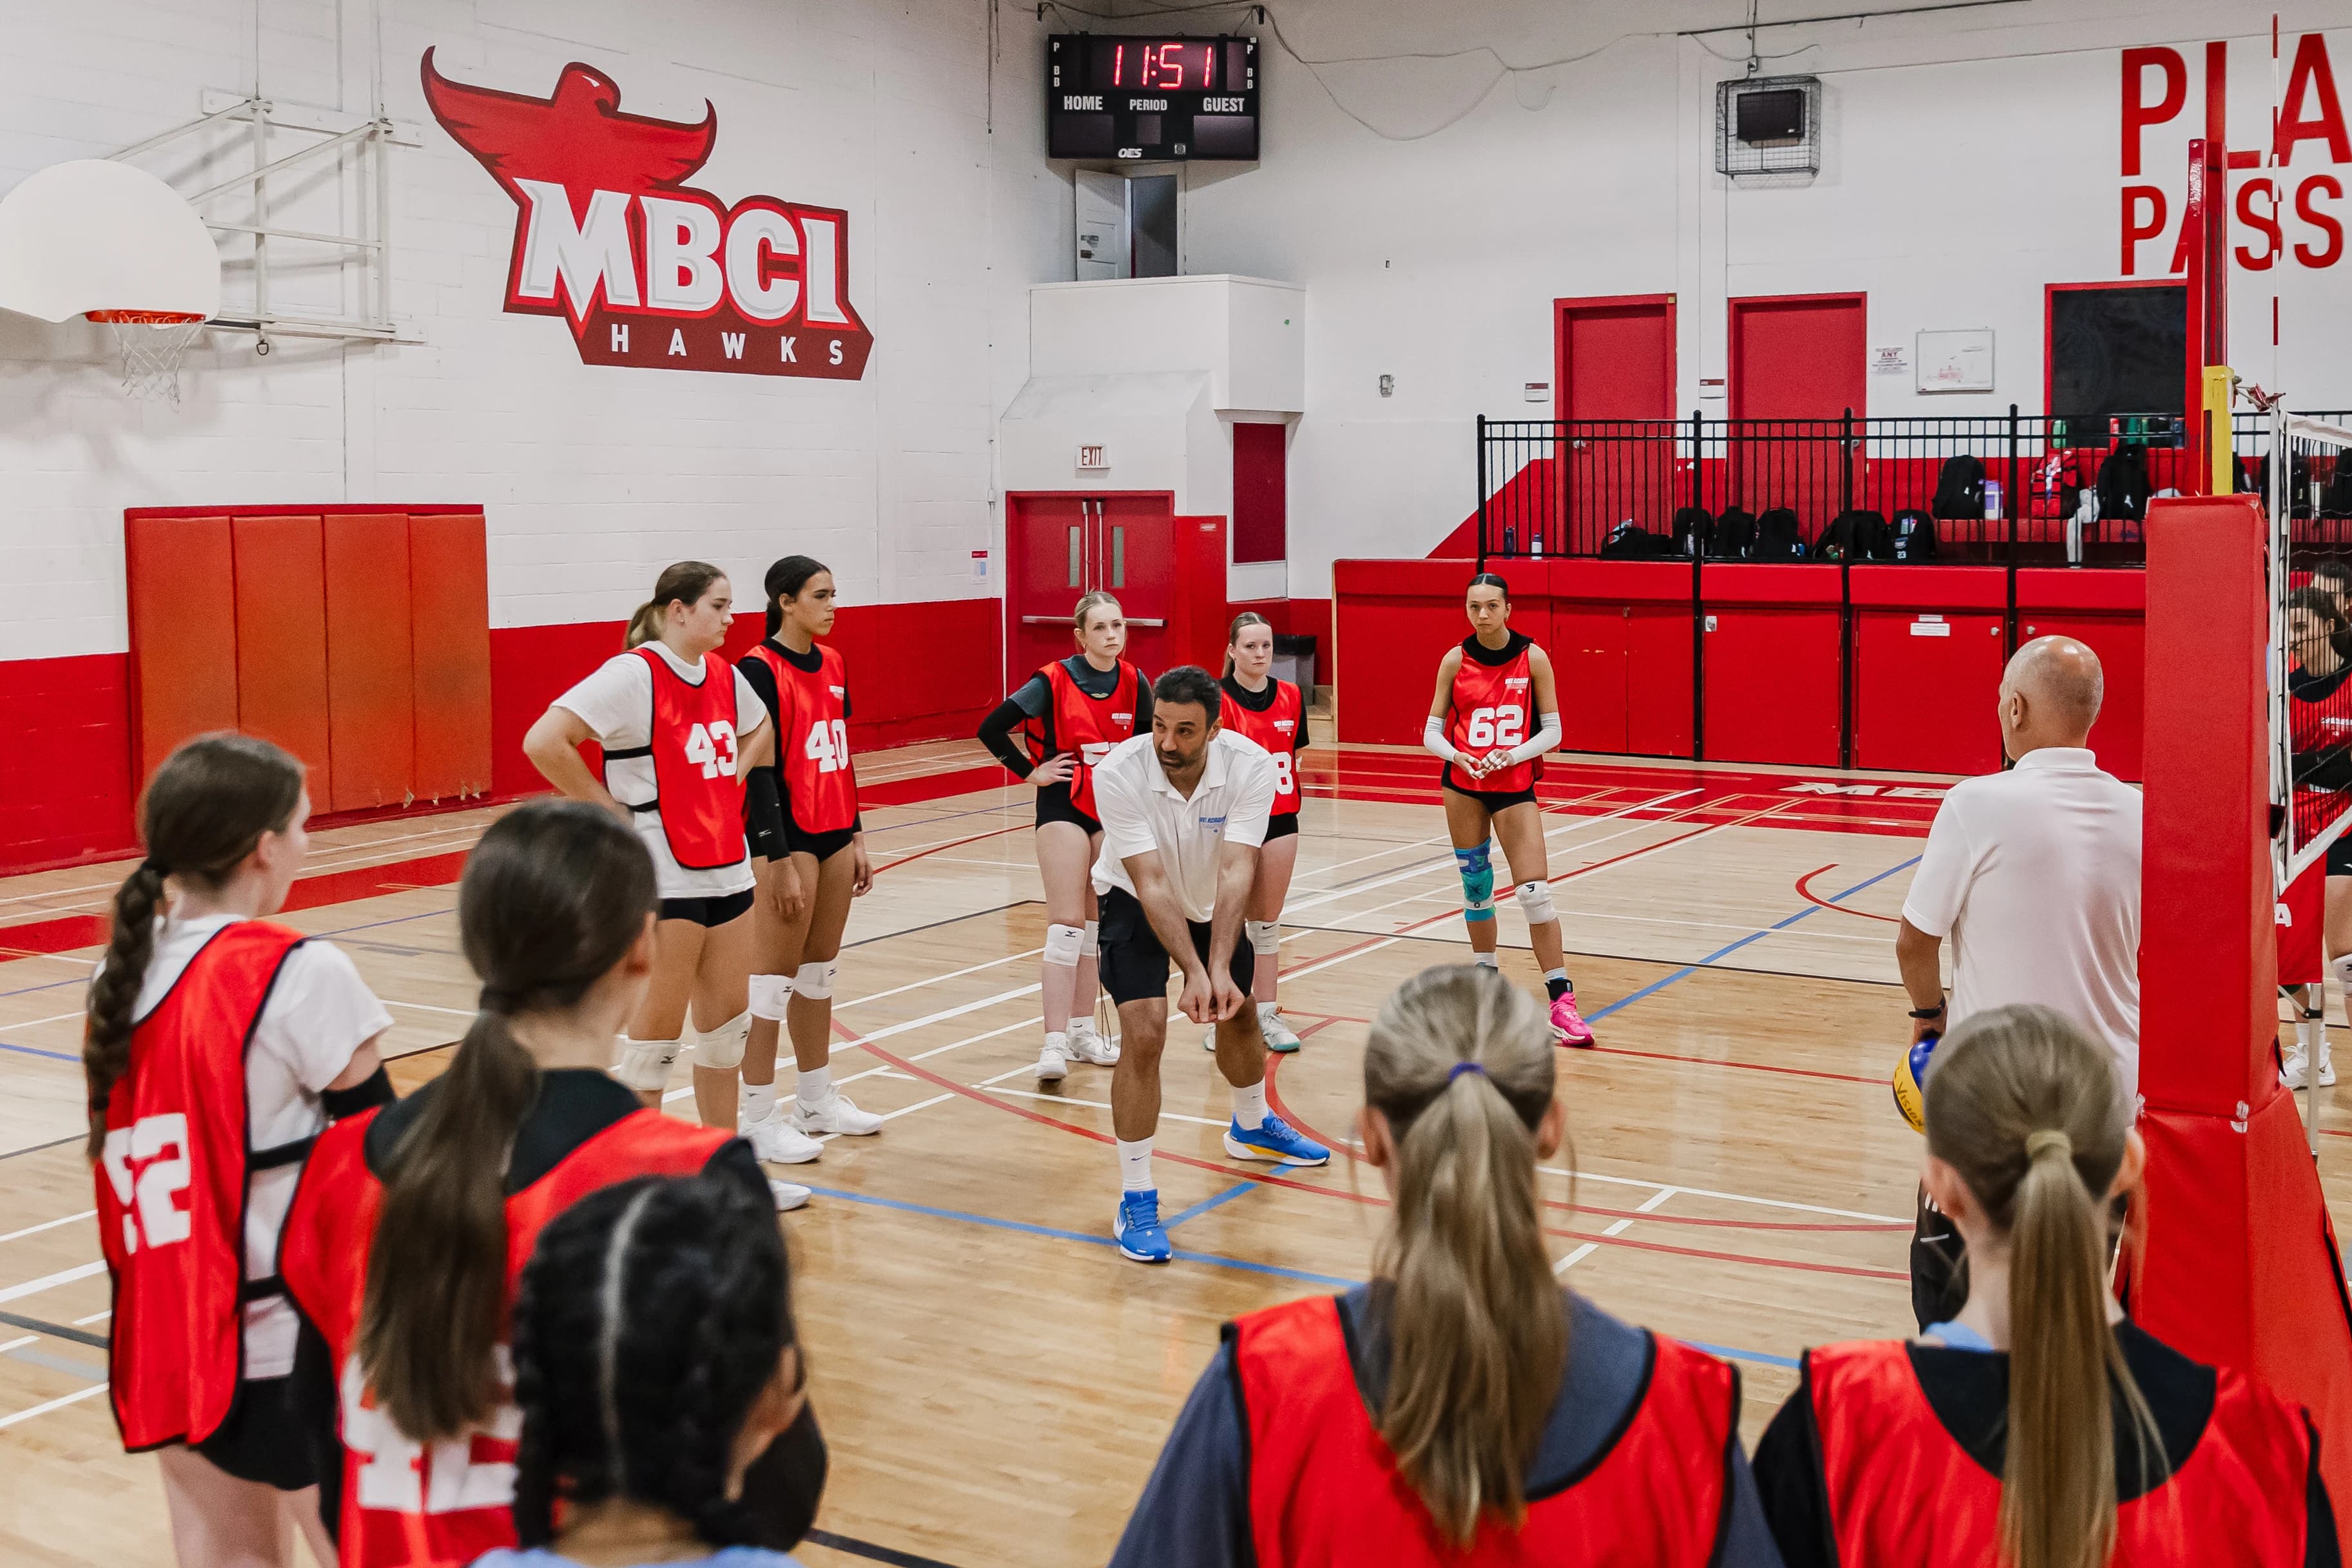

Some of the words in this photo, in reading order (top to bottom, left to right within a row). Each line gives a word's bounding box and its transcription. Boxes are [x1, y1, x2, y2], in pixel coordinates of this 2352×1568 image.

[1053, 42, 1060, 52] P
[1113, 43, 1212, 90] 11:51
[1247, 44, 1254, 54] P
[1064, 96, 1103, 110] HOME
[1129, 99, 1167, 111] PERIOD
[1203, 97, 1245, 112] GUEST
[2121, 175, 2344, 276] PSS
[512, 177, 848, 325] MBCI
[611, 324, 844, 366] HAWKS
[1082, 446, 1103, 465] EXIT
[805, 719, 849, 773] 40
[1468, 704, 1524, 747] 62
[685, 719, 739, 780] 43
